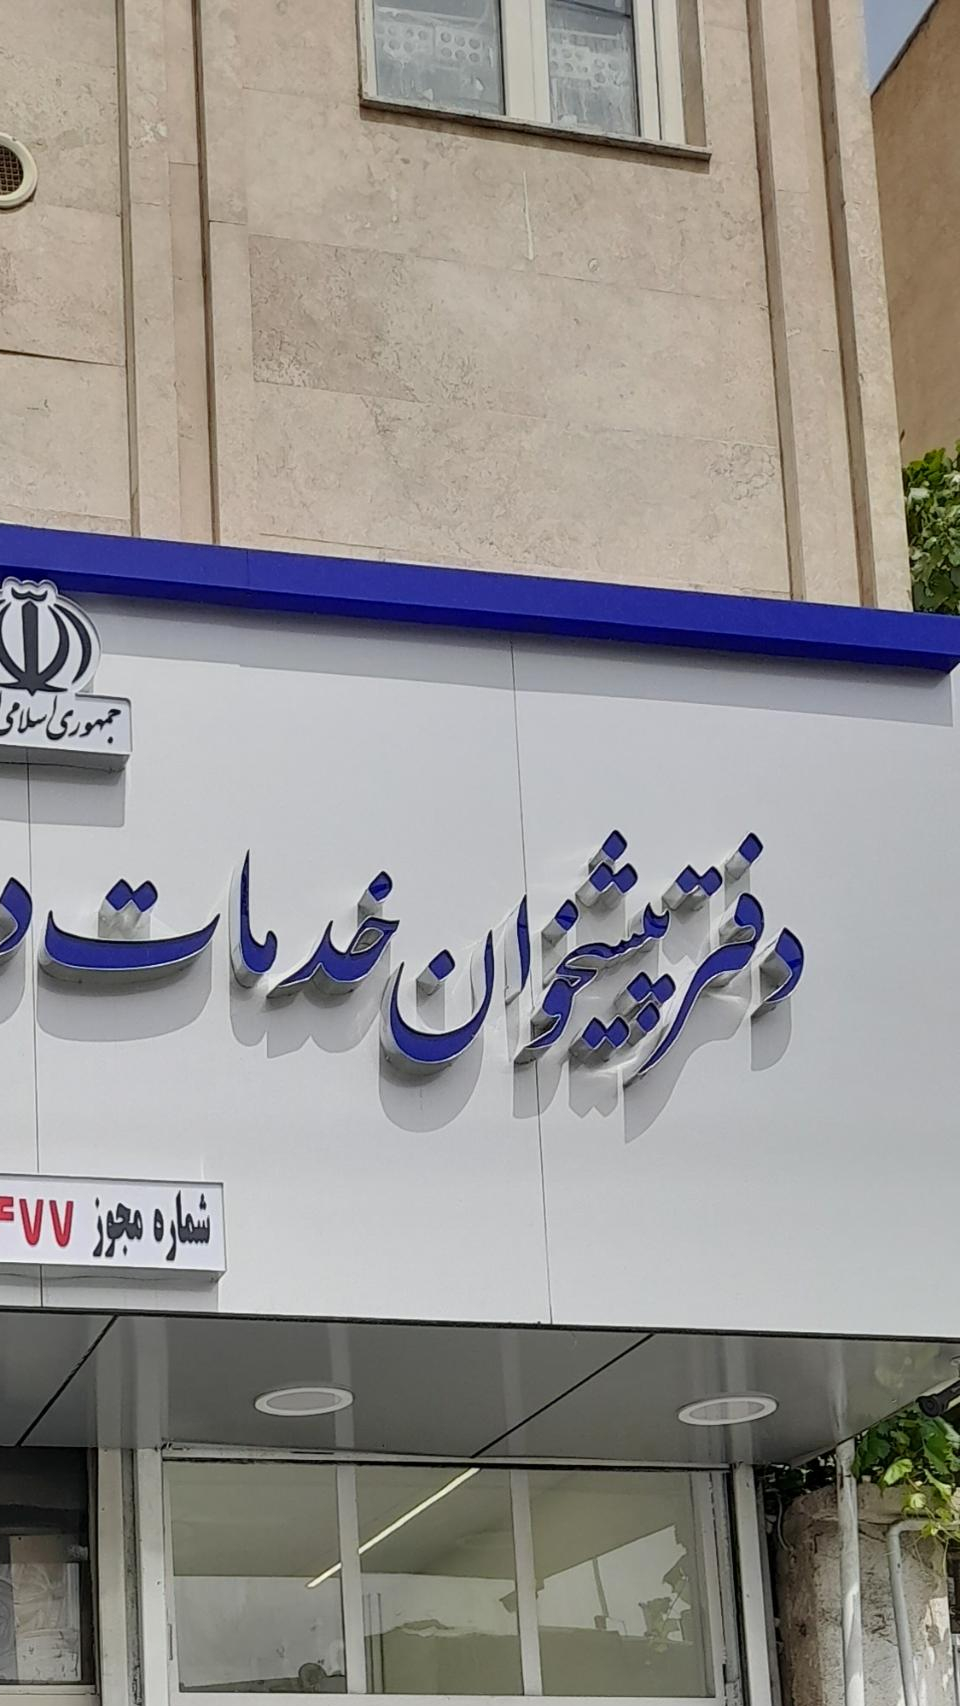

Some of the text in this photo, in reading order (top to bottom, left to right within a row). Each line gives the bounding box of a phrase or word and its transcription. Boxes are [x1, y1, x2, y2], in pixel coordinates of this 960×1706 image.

[46, 707, 122, 744] جمهوری
[44, 850, 399, 998] خدمات
[389, 829, 674, 1066] پیشخوان
[637, 832, 805, 1074] دفتر
[93, 1197, 144, 1258] مجوز
[153, 1190, 211, 1261] شماره
